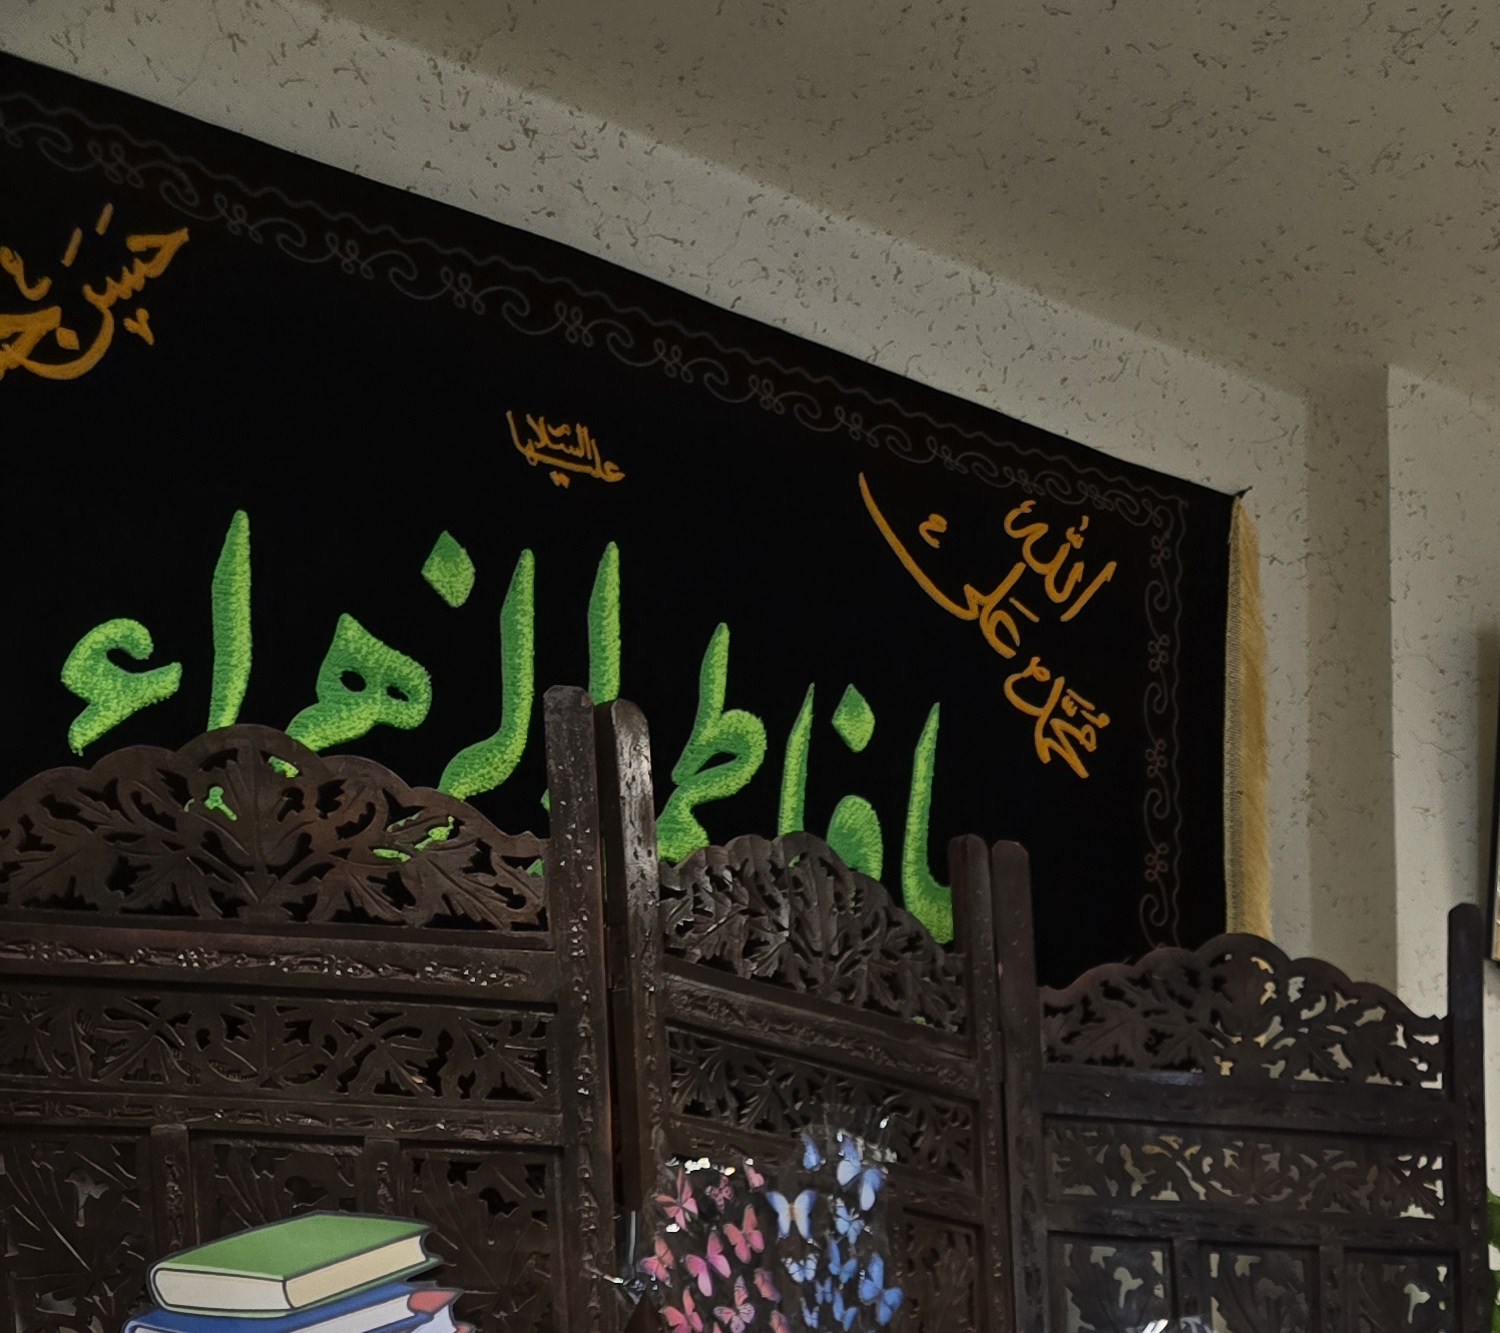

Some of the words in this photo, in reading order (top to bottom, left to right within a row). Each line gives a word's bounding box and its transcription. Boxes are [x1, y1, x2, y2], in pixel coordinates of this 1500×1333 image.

[858, 471, 1041, 659] علی
[1003, 499, 1118, 622] الله
[1003, 656, 1111, 779] محمد
